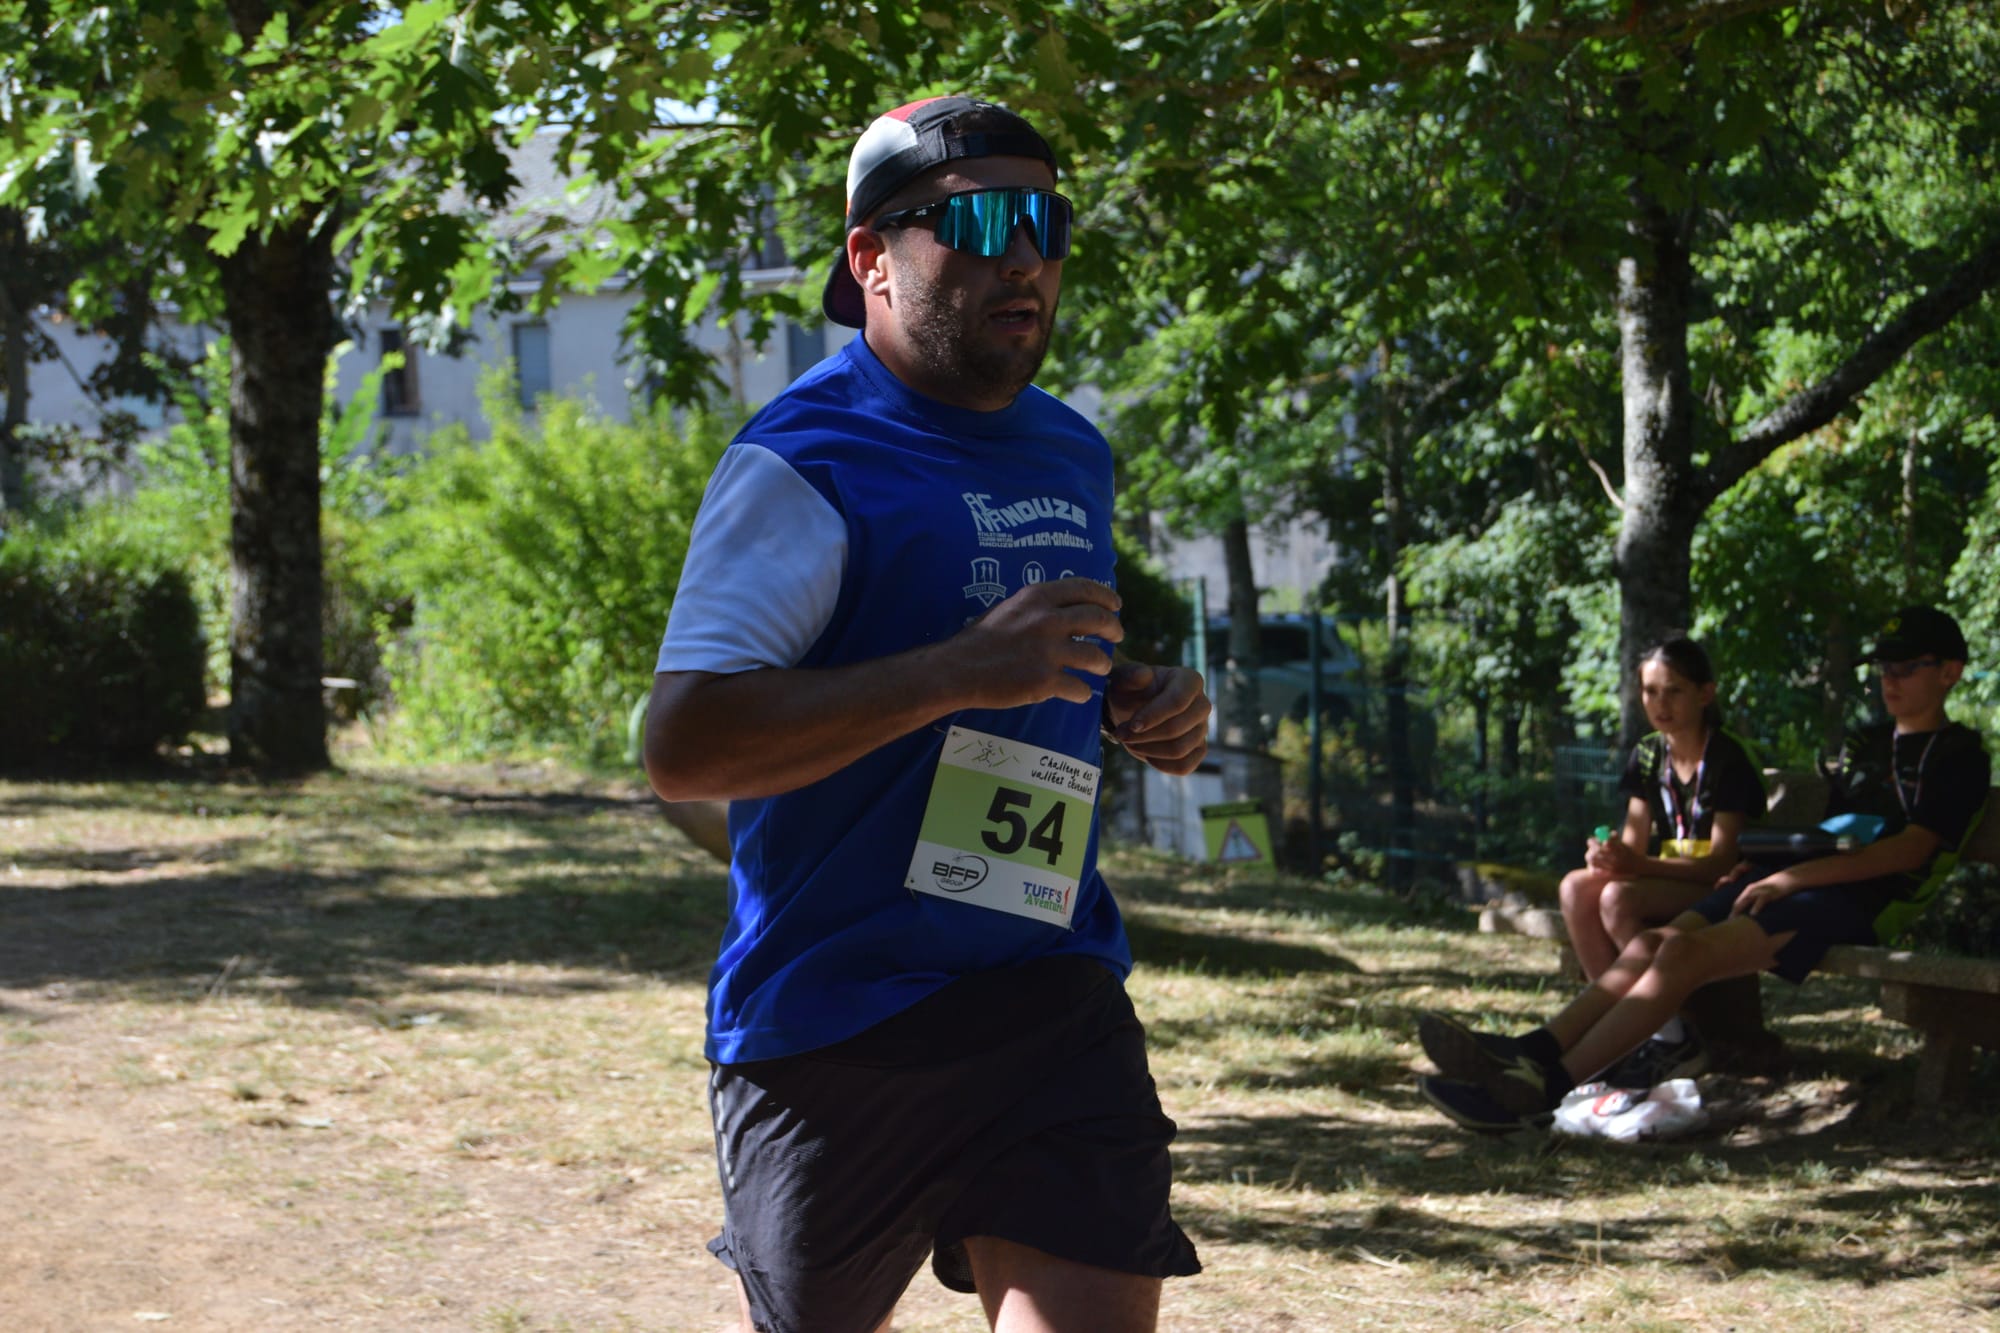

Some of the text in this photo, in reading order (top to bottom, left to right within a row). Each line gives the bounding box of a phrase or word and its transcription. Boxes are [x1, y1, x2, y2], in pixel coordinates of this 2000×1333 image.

[1031, 769, 1064, 785] vallées
[1040, 755, 1093, 781] Challenge des
[981, 786, 1066, 866] 54
[932, 862, 980, 882] BFP
[940, 877, 964, 887] GROUP
[1023, 881, 1063, 904] TUFF'S
